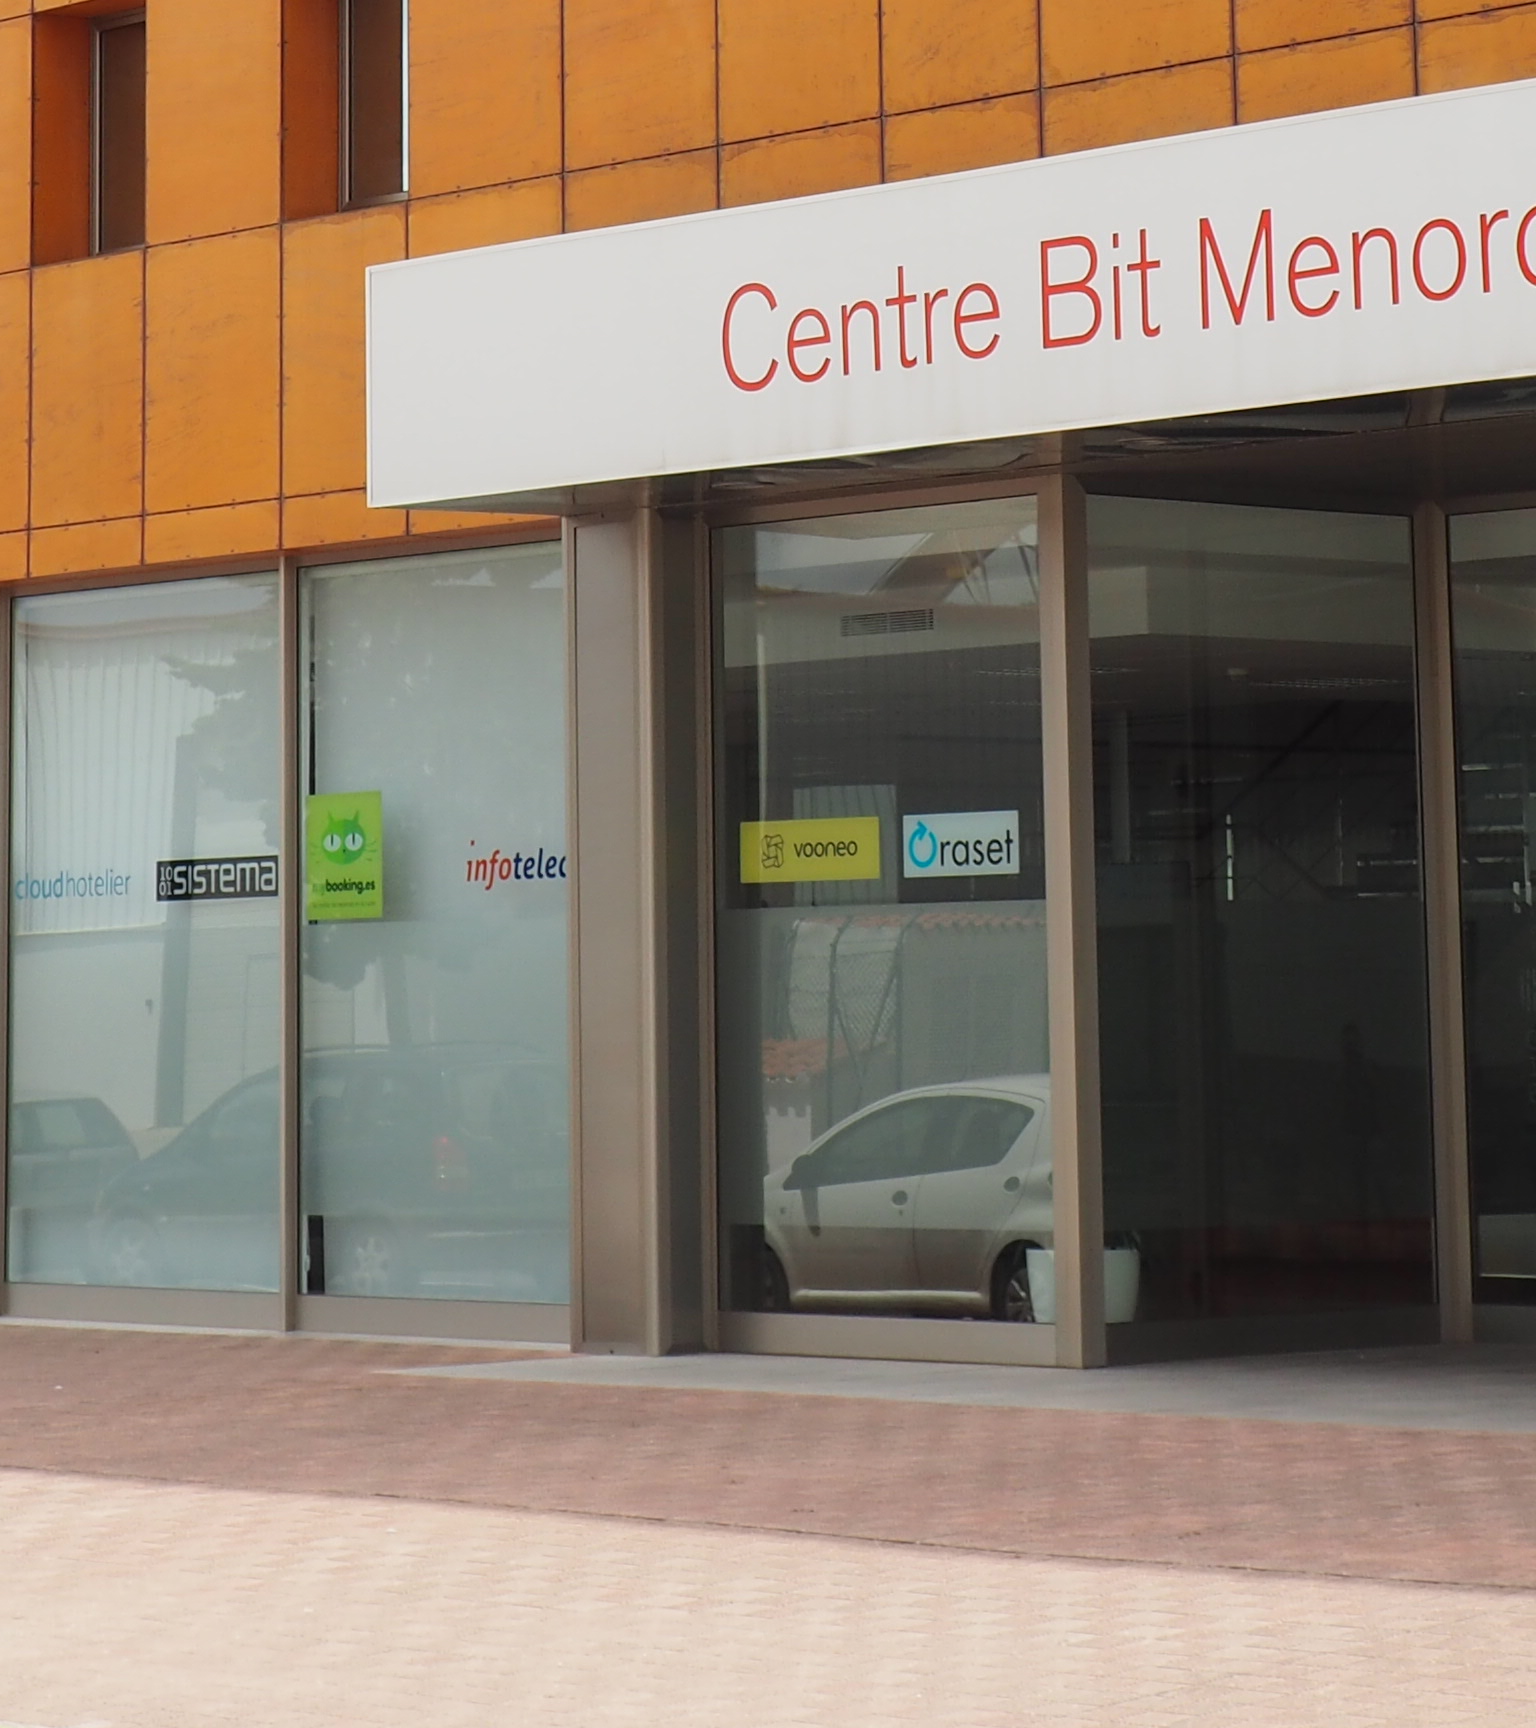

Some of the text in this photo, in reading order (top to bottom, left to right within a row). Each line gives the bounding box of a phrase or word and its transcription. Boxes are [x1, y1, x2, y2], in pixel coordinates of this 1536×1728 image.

[722, 266, 1001, 392] Centre
[1040, 229, 1163, 349] Bit
[793, 838, 859, 859] vooneo
[15, 868, 131, 900] cloudhotelier
